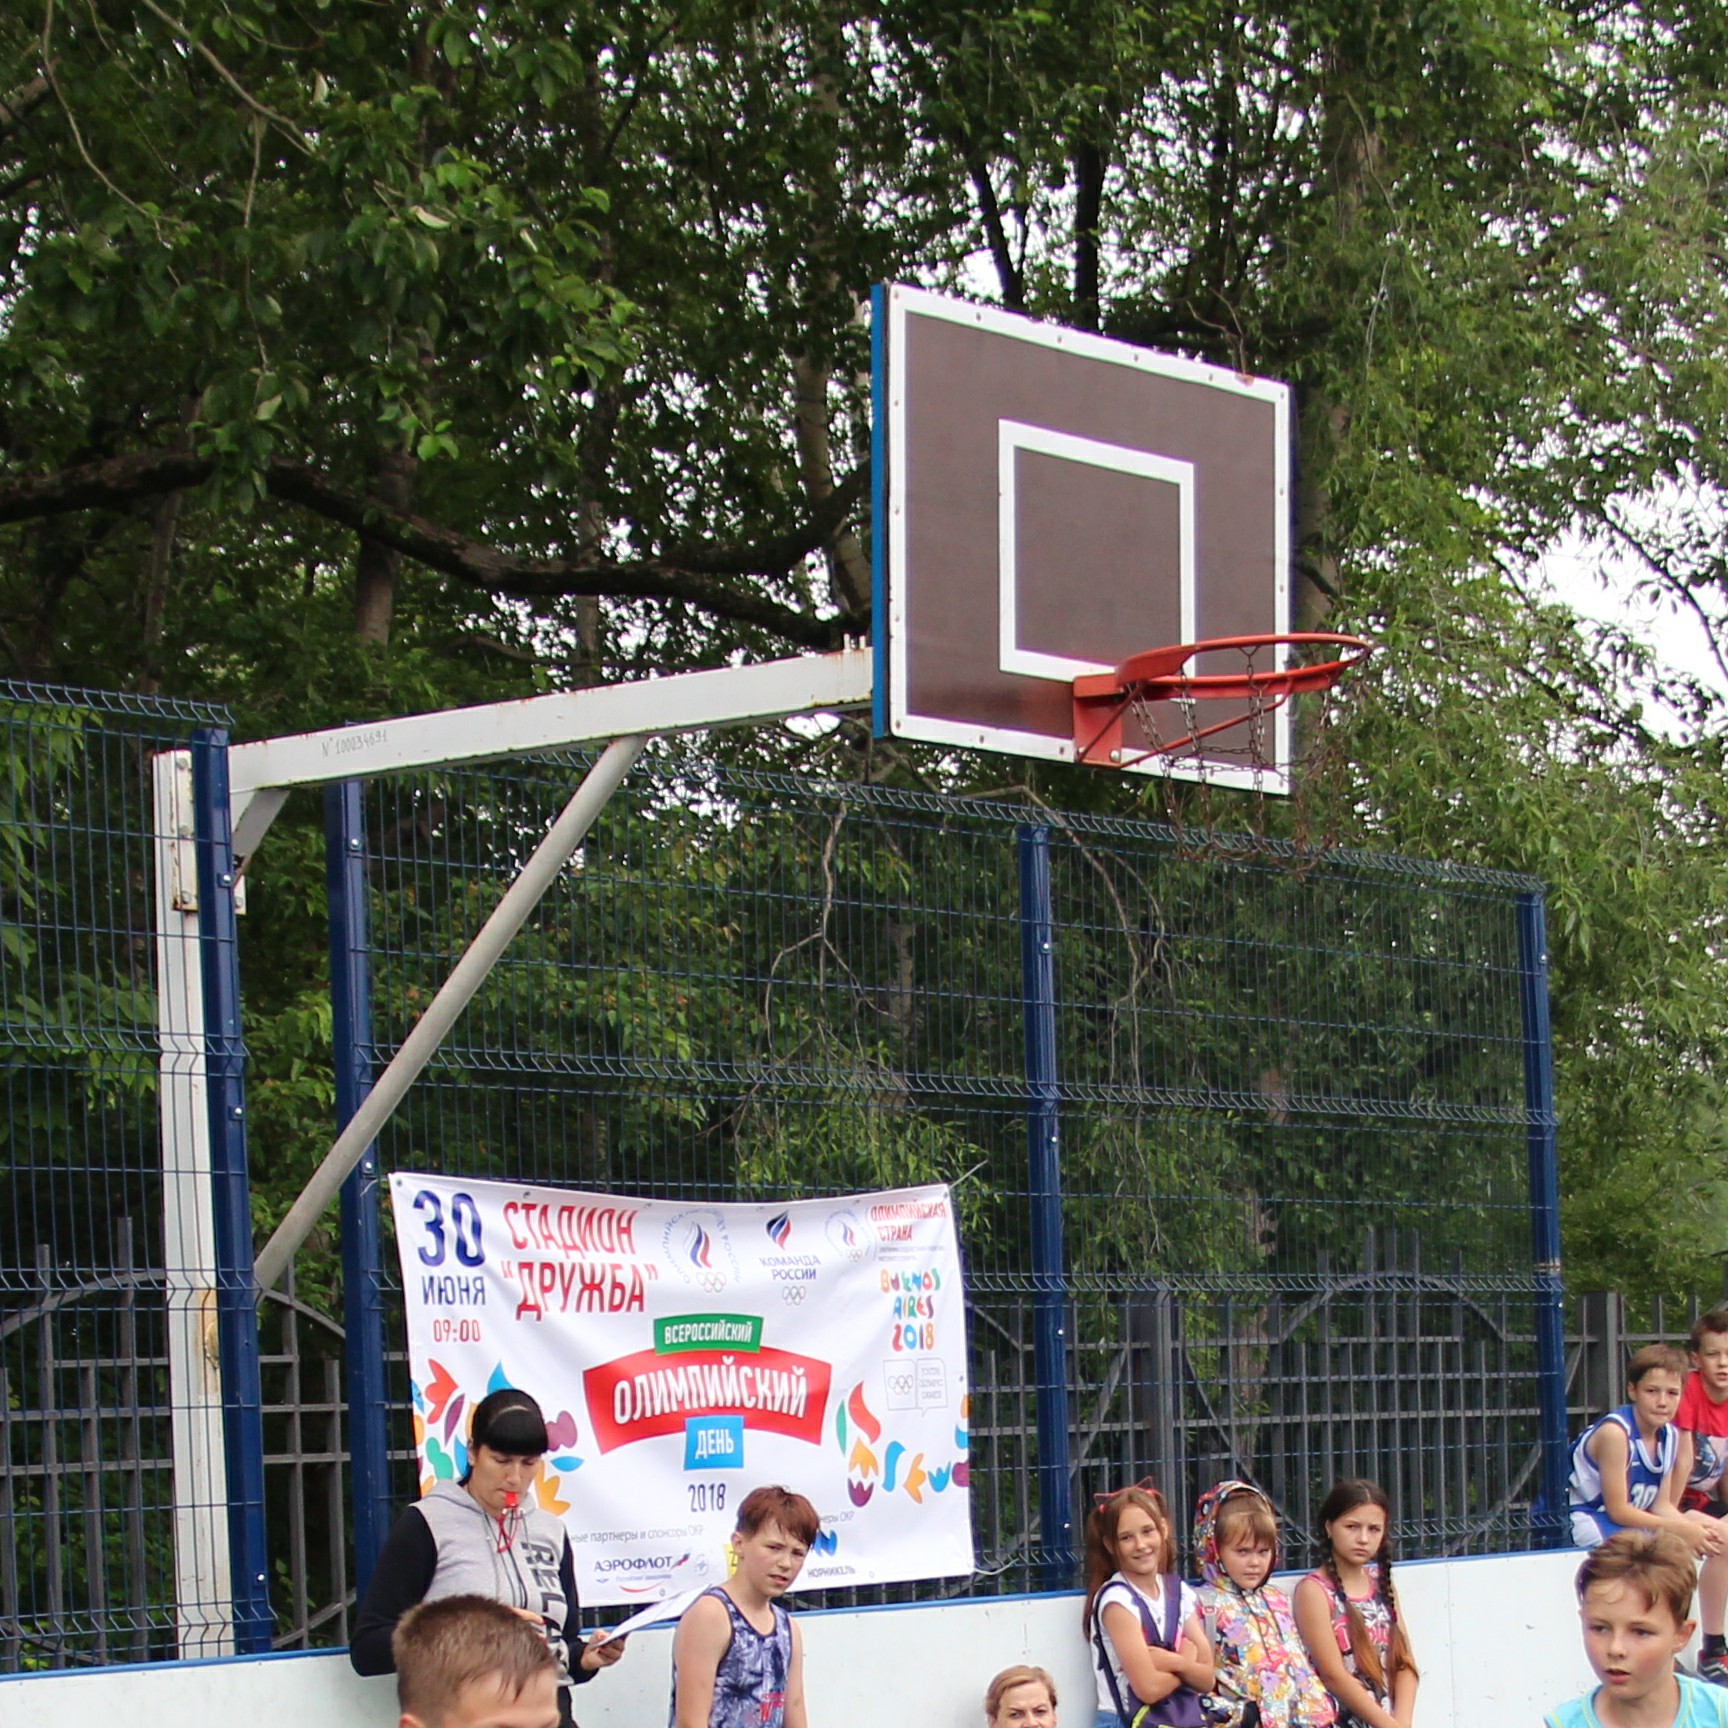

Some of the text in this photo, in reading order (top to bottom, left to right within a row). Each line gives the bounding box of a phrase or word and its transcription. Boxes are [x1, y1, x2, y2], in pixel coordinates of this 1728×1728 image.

[412, 1189, 486, 1267] 30
[503, 1201, 638, 1259] СТАДИОН
[877, 1224, 913, 1242] СТРАНА
[759, 1255, 821, 1267] КОМАНДА
[772, 1268, 816, 1280] РОССИИ
[880, 1268, 941, 1293] BUENOS
[422, 1275, 486, 1305] ИЮНЯ
[893, 1295, 934, 1320] AIRES
[433, 1319, 481, 1342] 09:00
[664, 1319, 753, 1344] ВСЕРОССИЙСКИЙ
[892, 1322, 934, 1352] 2018
[614, 1356, 807, 1424] ОЛИМПИЙСКИЙ
[695, 1428, 734, 1460] ДЕНЬ
[688, 1483, 726, 1512] 2018
[590, 1530, 638, 1544] партнеры
[640, 1531, 646, 1539] и
[594, 1556, 673, 1573] АЭРОФЛОТ
